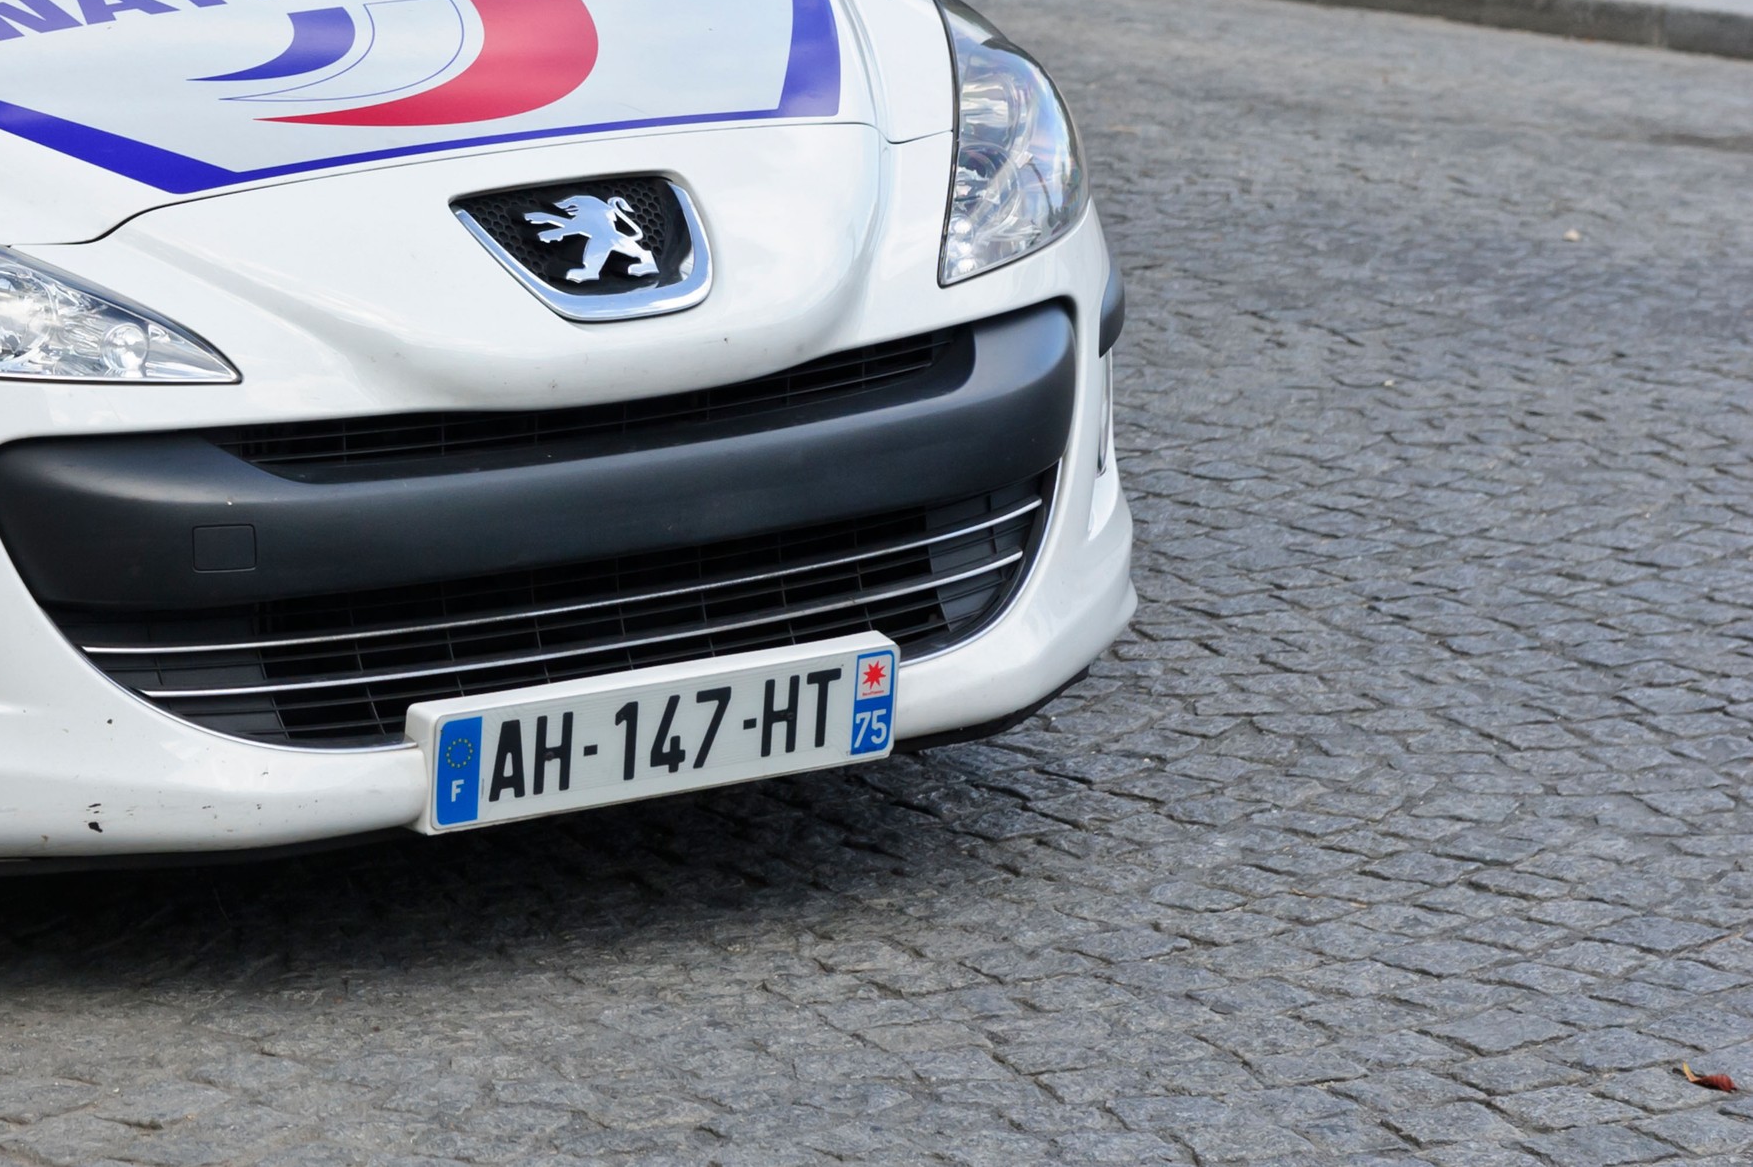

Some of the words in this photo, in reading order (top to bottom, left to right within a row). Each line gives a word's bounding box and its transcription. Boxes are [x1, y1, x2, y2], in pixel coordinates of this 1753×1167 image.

[488, 667, 842, 803] AH-147-HT
[854, 709, 887, 748] 75
[451, 779, 464, 803] F
